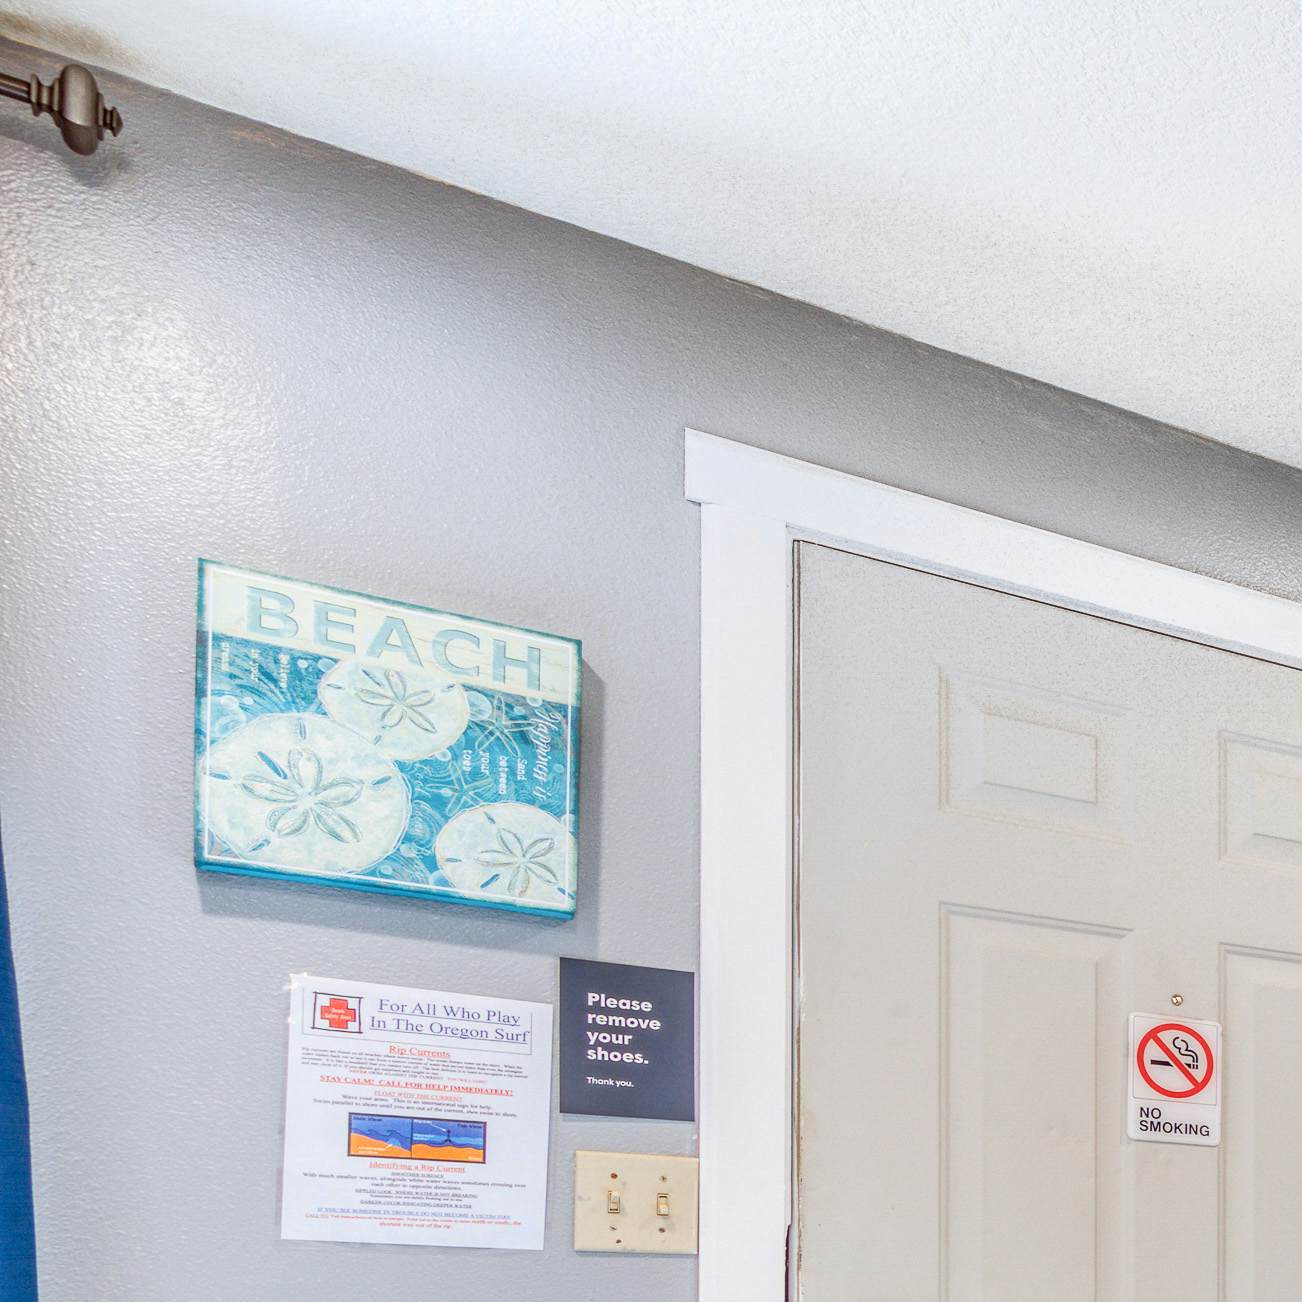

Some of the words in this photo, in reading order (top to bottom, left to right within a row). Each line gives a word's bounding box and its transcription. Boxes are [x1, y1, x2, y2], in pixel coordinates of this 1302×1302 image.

[244, 586, 541, 691] BEACH
[587, 992, 653, 1012] Please
[378, 998, 407, 1013] For
[412, 1002, 436, 1016] All
[443, 1005, 481, 1020] Who
[487, 1009, 521, 1027] Play
[587, 1012, 662, 1031] remove
[370, 1016, 386, 1029] In
[392, 1018, 424, 1033] The
[429, 1021, 489, 1040] Oregon
[494, 1028, 530, 1043] Surf
[586, 1030, 633, 1047] your
[389, 1045, 406, 1056] Rip
[409, 1047, 450, 1059] Currents
[586, 1047, 649, 1065] shoes.
[587, 1076, 614, 1087] Thank
[615, 1079, 634, 1088] you.
[1139, 1106, 1162, 1119] NO
[1139, 1120, 1210, 1137] SMOKING
